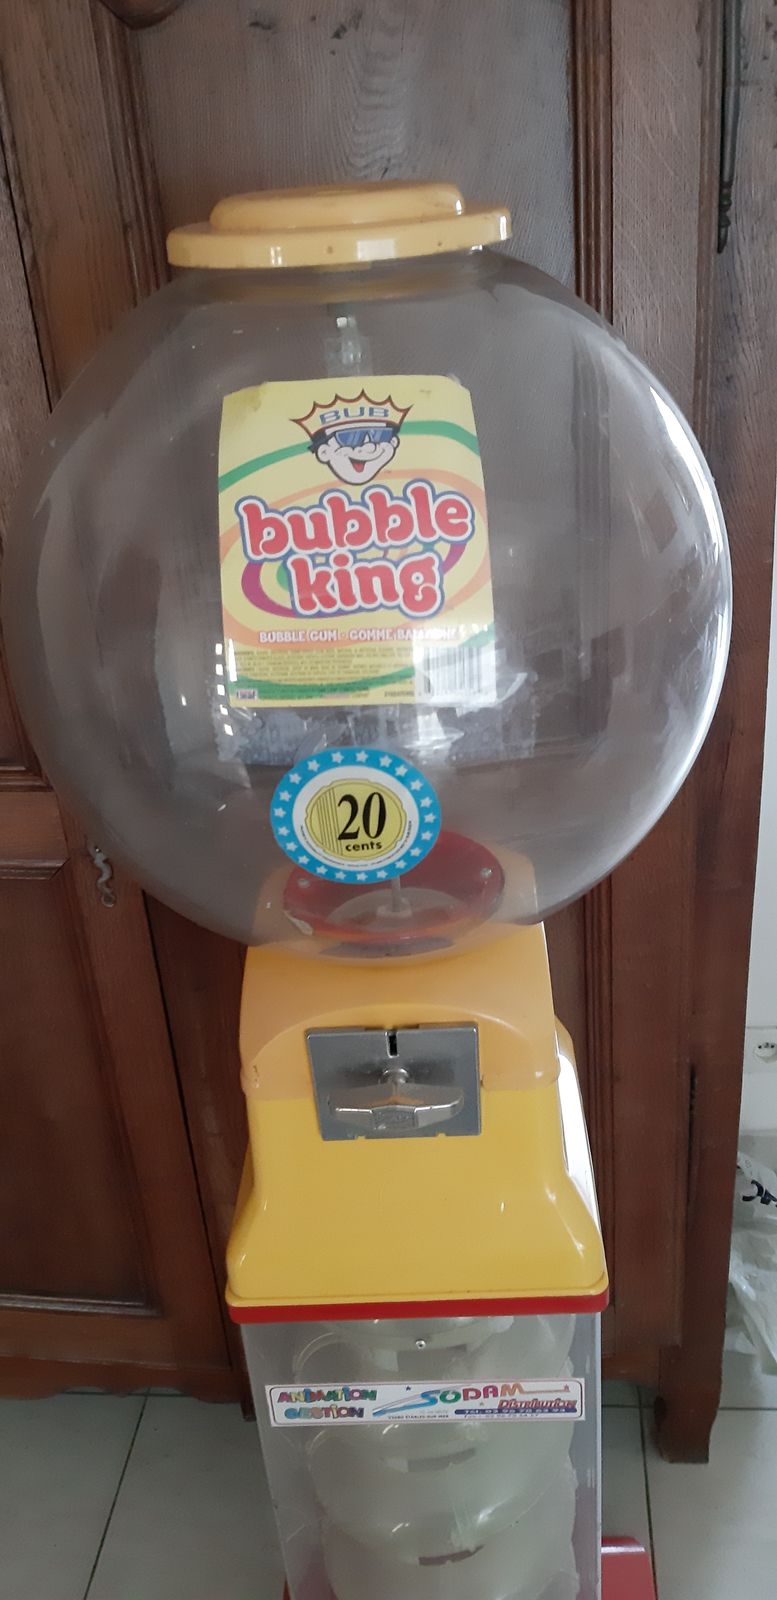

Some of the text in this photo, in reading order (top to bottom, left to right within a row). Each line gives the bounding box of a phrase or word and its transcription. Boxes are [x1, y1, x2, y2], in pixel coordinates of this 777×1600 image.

[319, 406, 389, 424] BUB
[237, 480, 473, 561] bubble
[284, 550, 442, 618] king
[259, 630, 305, 643] BUBBLE
[309, 629, 338, 641] GUM
[349, 628, 393, 641] GOMME
[337, 792, 387, 840] 20
[345, 841, 382, 852] cents
[420, 1383, 525, 1404] SODAM
[284, 1404, 364, 1419] GESTION
